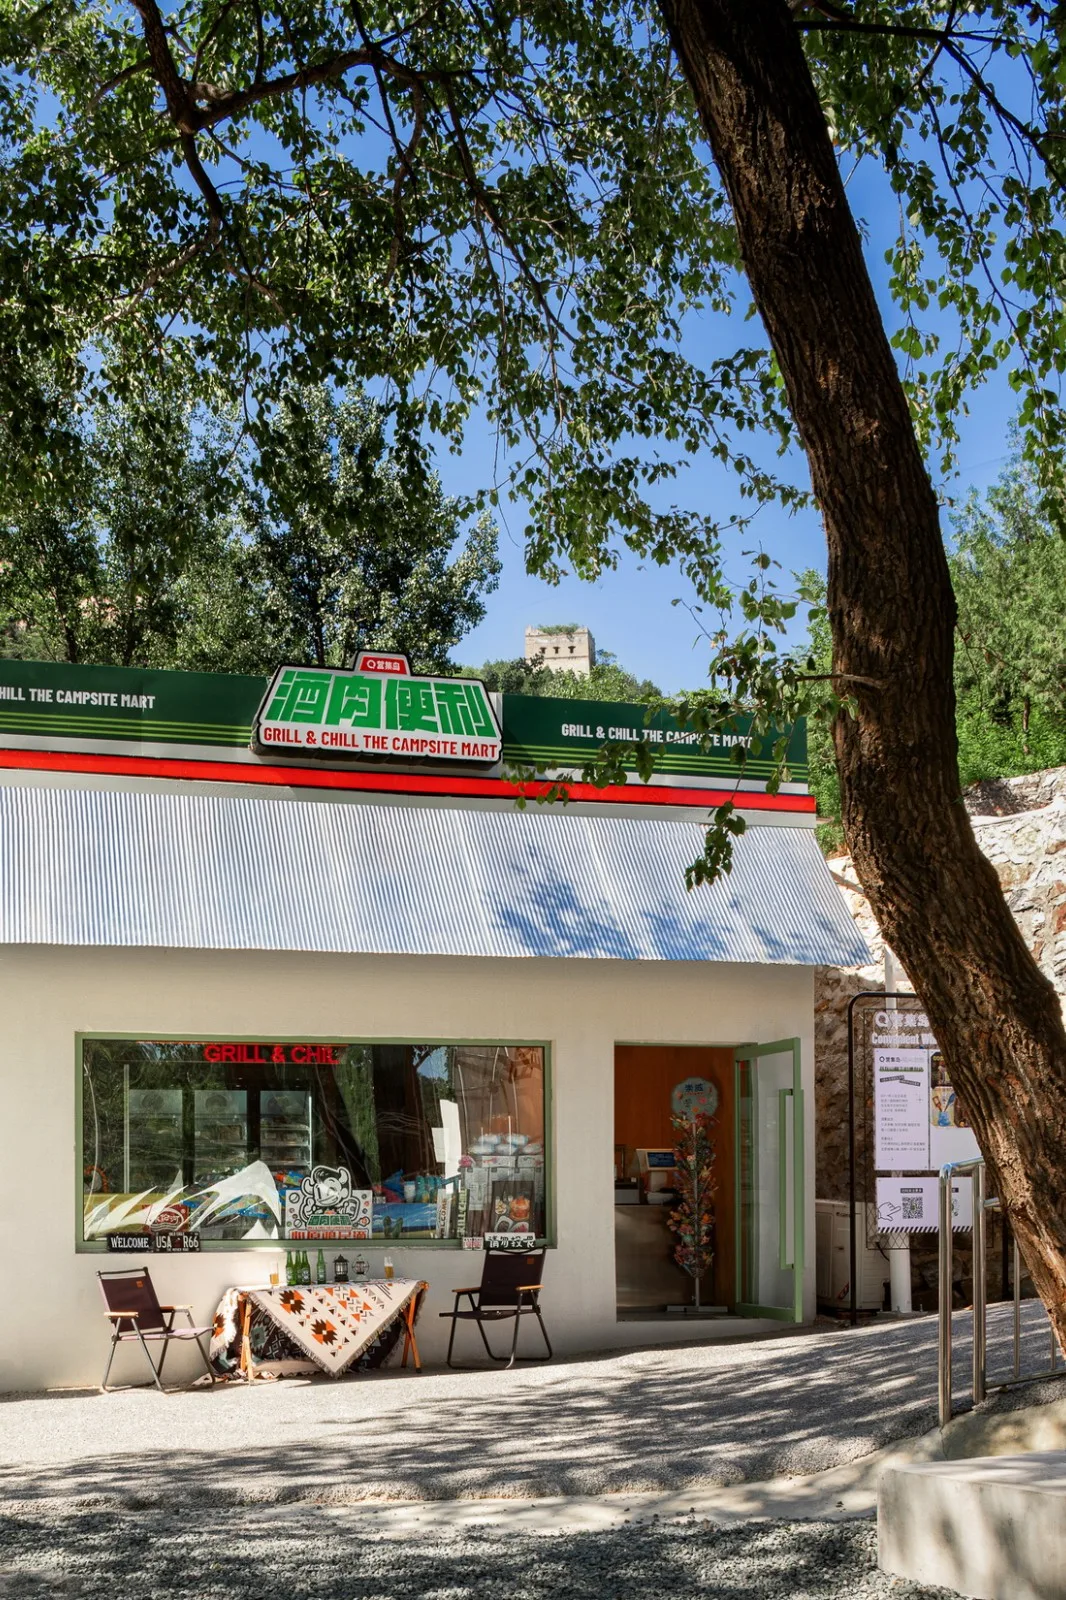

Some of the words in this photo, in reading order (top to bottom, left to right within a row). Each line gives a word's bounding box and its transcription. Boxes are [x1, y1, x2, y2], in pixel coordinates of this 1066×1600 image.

[29, 688, 53, 702] THE
[56, 690, 118, 707] CAMPSITE
[121, 694, 156, 709] MART
[263, 727, 301, 743] GRILL
[306, 730, 317, 744] &
[321, 731, 359, 748] CHILL
[363, 735, 388, 750] THE
[392, 737, 457, 755] CAMPSITE
[461, 742, 497, 758] MART
[561, 723, 593, 738] GRILL
[596, 726, 605, 739] &
[608, 727, 640, 741] CHILL
[642, 729, 664, 743] THE
[666, 731, 721, 747] CAMPSE
[203, 1044, 266, 1063] GRILL
[271, 1045, 286, 1063] &
[111, 1235, 149, 1248] WELCOME
[156, 1235, 172, 1248] USA
[183, 1235, 199, 1248] R66
